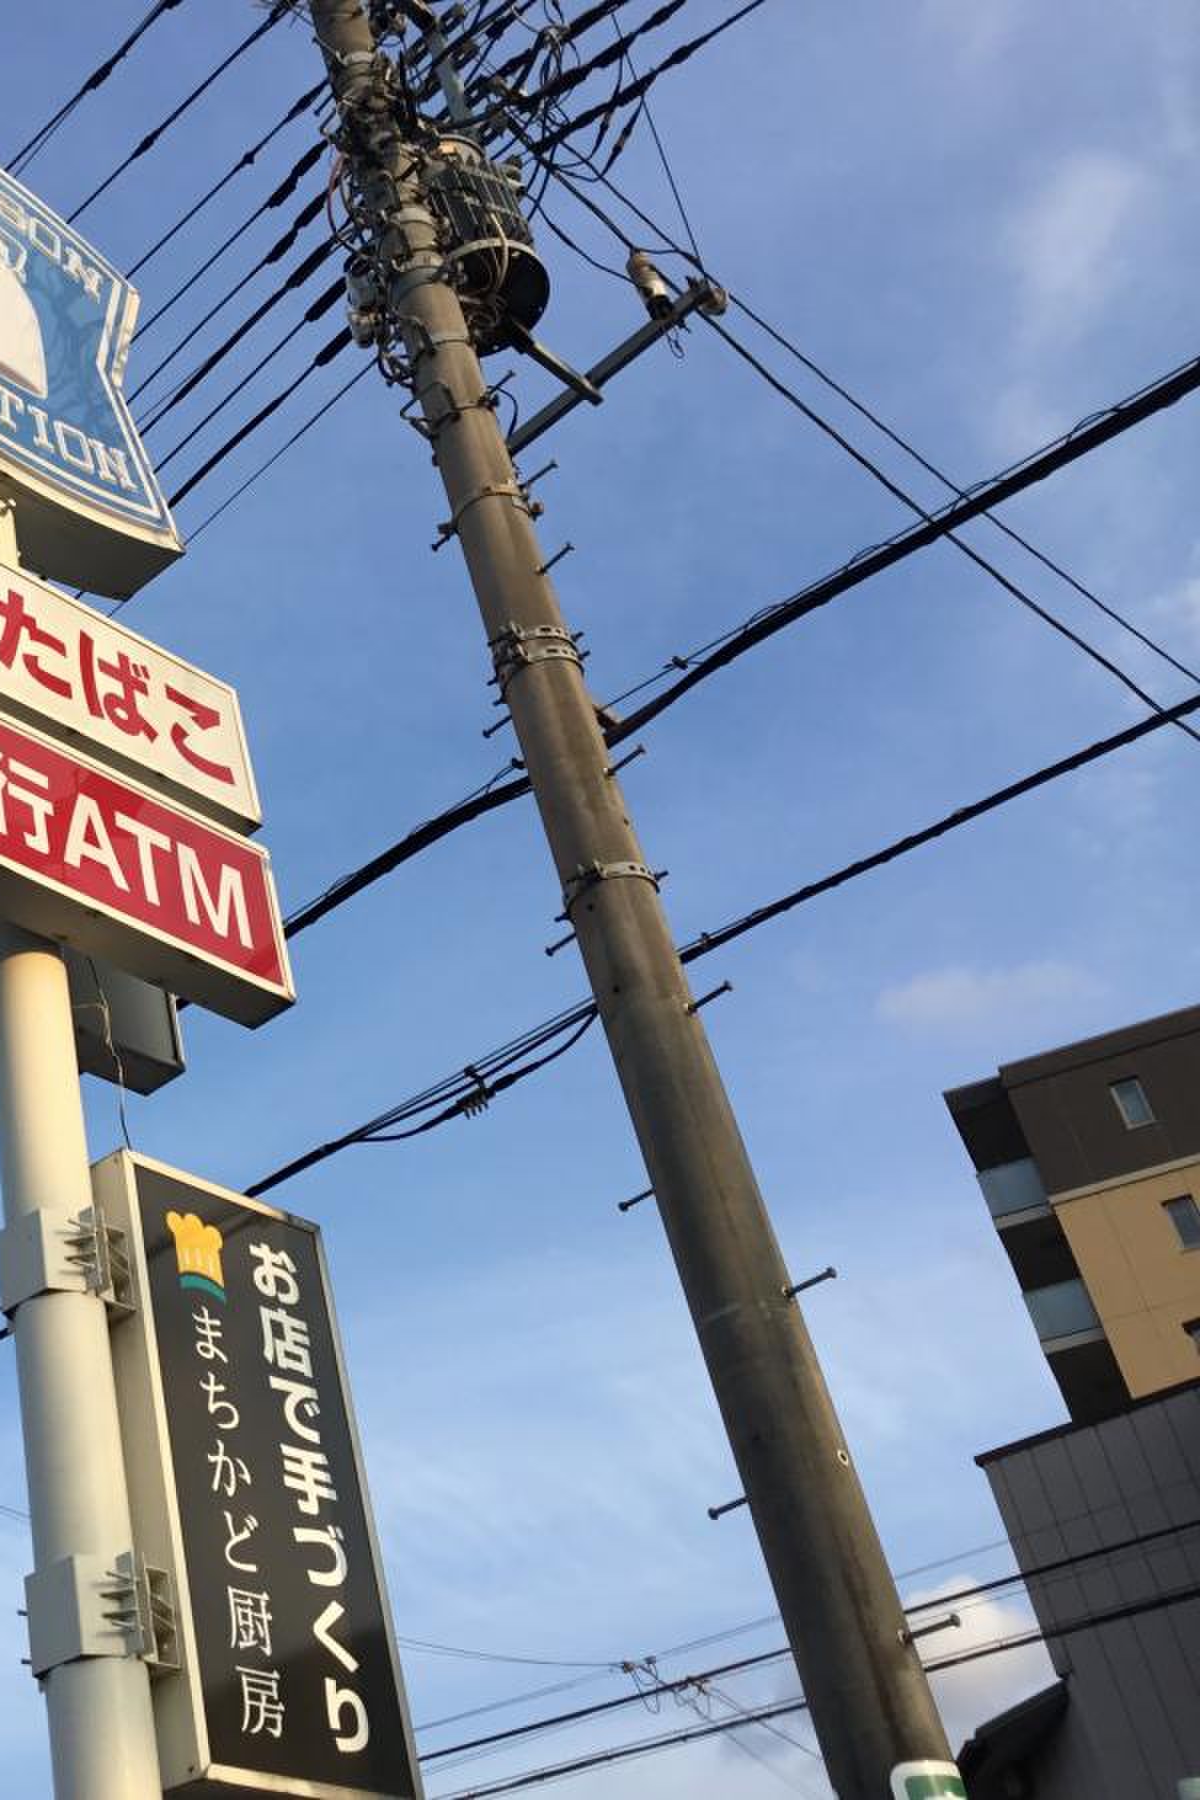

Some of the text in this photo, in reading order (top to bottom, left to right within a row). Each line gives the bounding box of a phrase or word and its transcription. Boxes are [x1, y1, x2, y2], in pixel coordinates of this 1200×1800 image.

[192, 1306, 286, 1739] まちかど厨房
[249, 1241, 369, 1753] お店で手づくり
